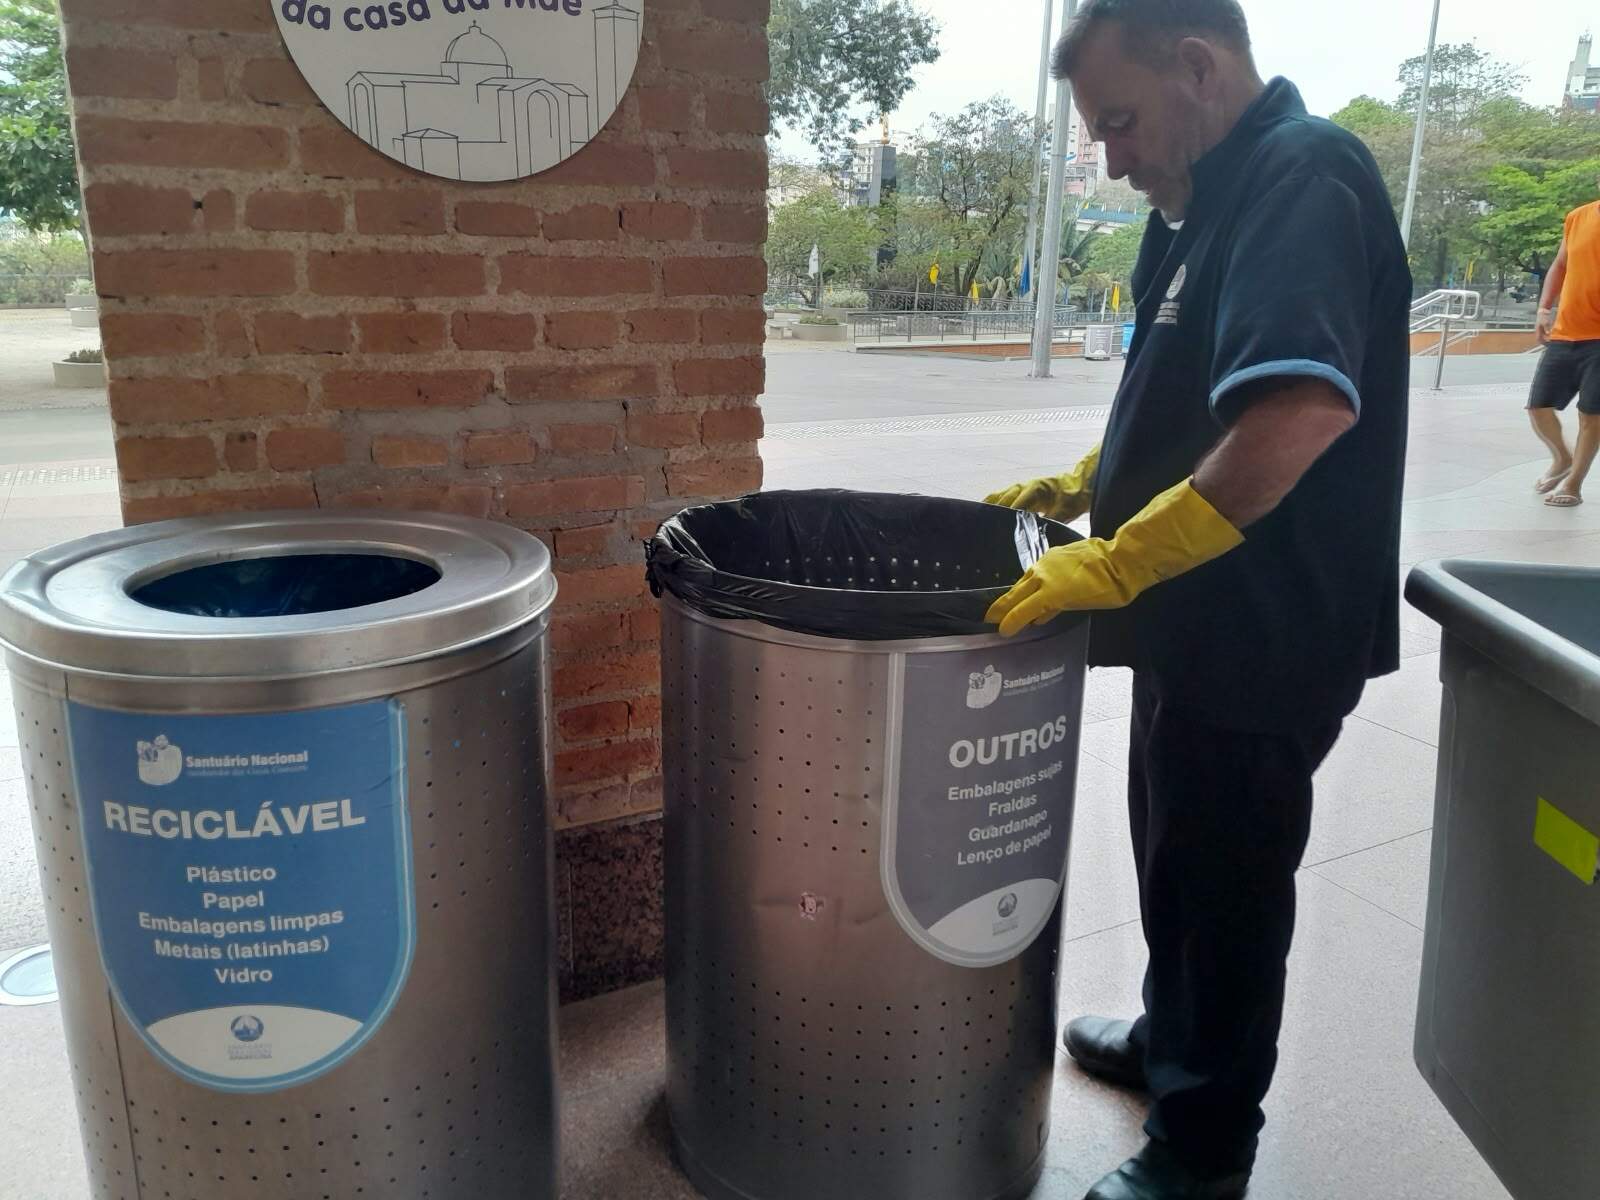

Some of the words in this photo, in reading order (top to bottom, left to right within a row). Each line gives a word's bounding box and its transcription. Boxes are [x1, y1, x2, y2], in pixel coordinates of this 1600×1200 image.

[344, 0, 431, 31] casa
[949, 715, 1067, 768] OUTROS
[186, 755, 249, 768] Santuário
[251, 750, 308, 766] Nacional
[948, 774, 1036, 800] Embalagens
[988, 794, 1037, 817] Fraldas
[103, 799, 366, 840] RECICLÁVEL
[968, 809, 1048, 842] Guardanapo
[957, 847, 1003, 865] Lenço
[1005, 841, 1022, 856] de
[1023, 824, 1052, 853] papel
[186, 866, 276, 883] Plástico
[203, 891, 265, 912] Papel
[138, 912, 266, 938] Embalagens
[270, 910, 344, 932] limpas
[154, 939, 222, 960] Metais
[227, 936, 330, 960] (latinhas)
[214, 968, 273, 984] Vidro
